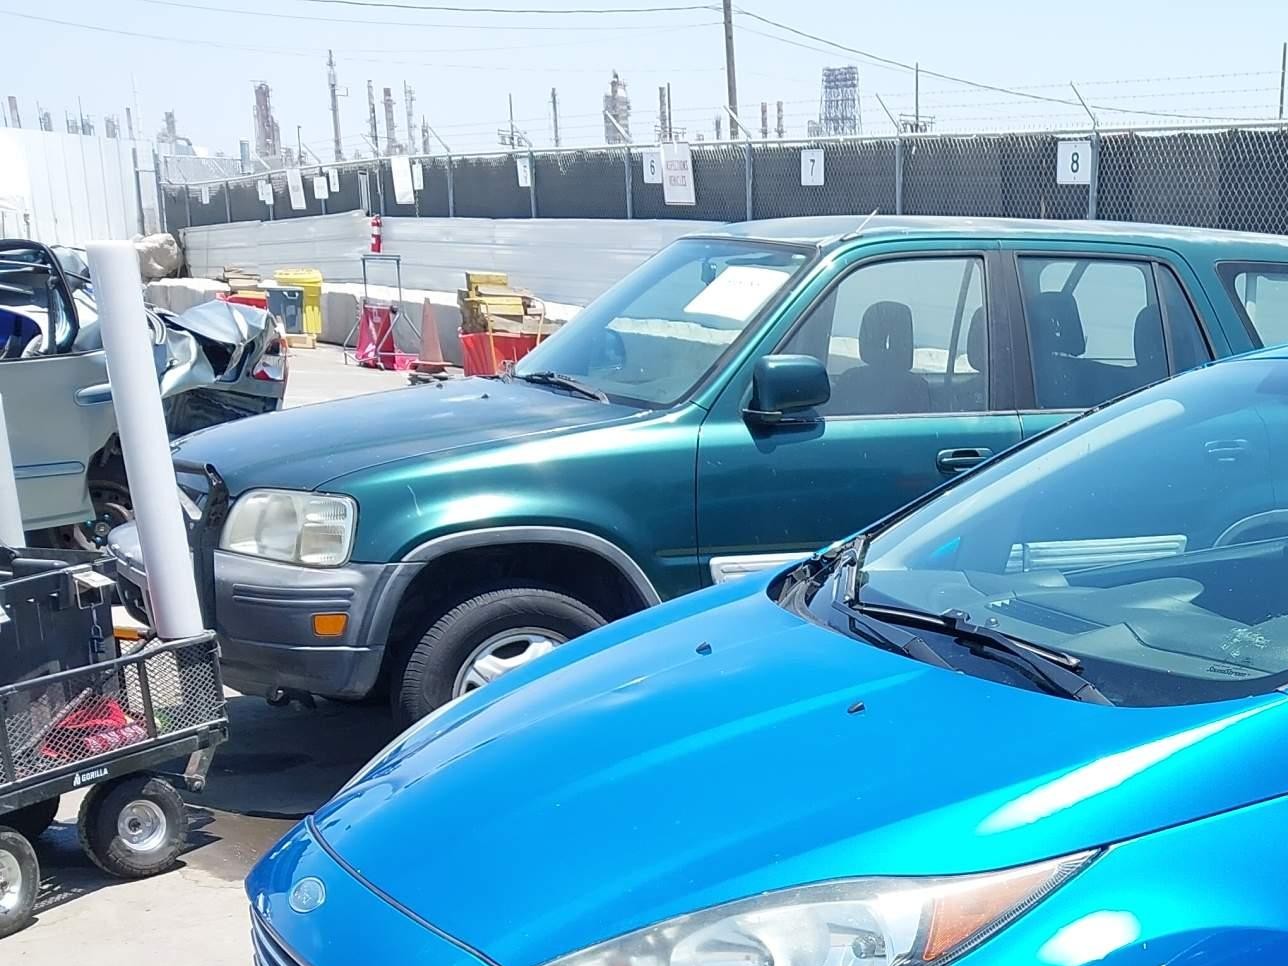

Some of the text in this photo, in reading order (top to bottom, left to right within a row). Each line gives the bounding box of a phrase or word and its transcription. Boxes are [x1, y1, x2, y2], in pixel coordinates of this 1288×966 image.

[649, 159, 656, 176] 6
[808, 158, 816, 177] 7
[1070, 151, 1080, 174] 8
[81, 767, 109, 782] GORILLA
